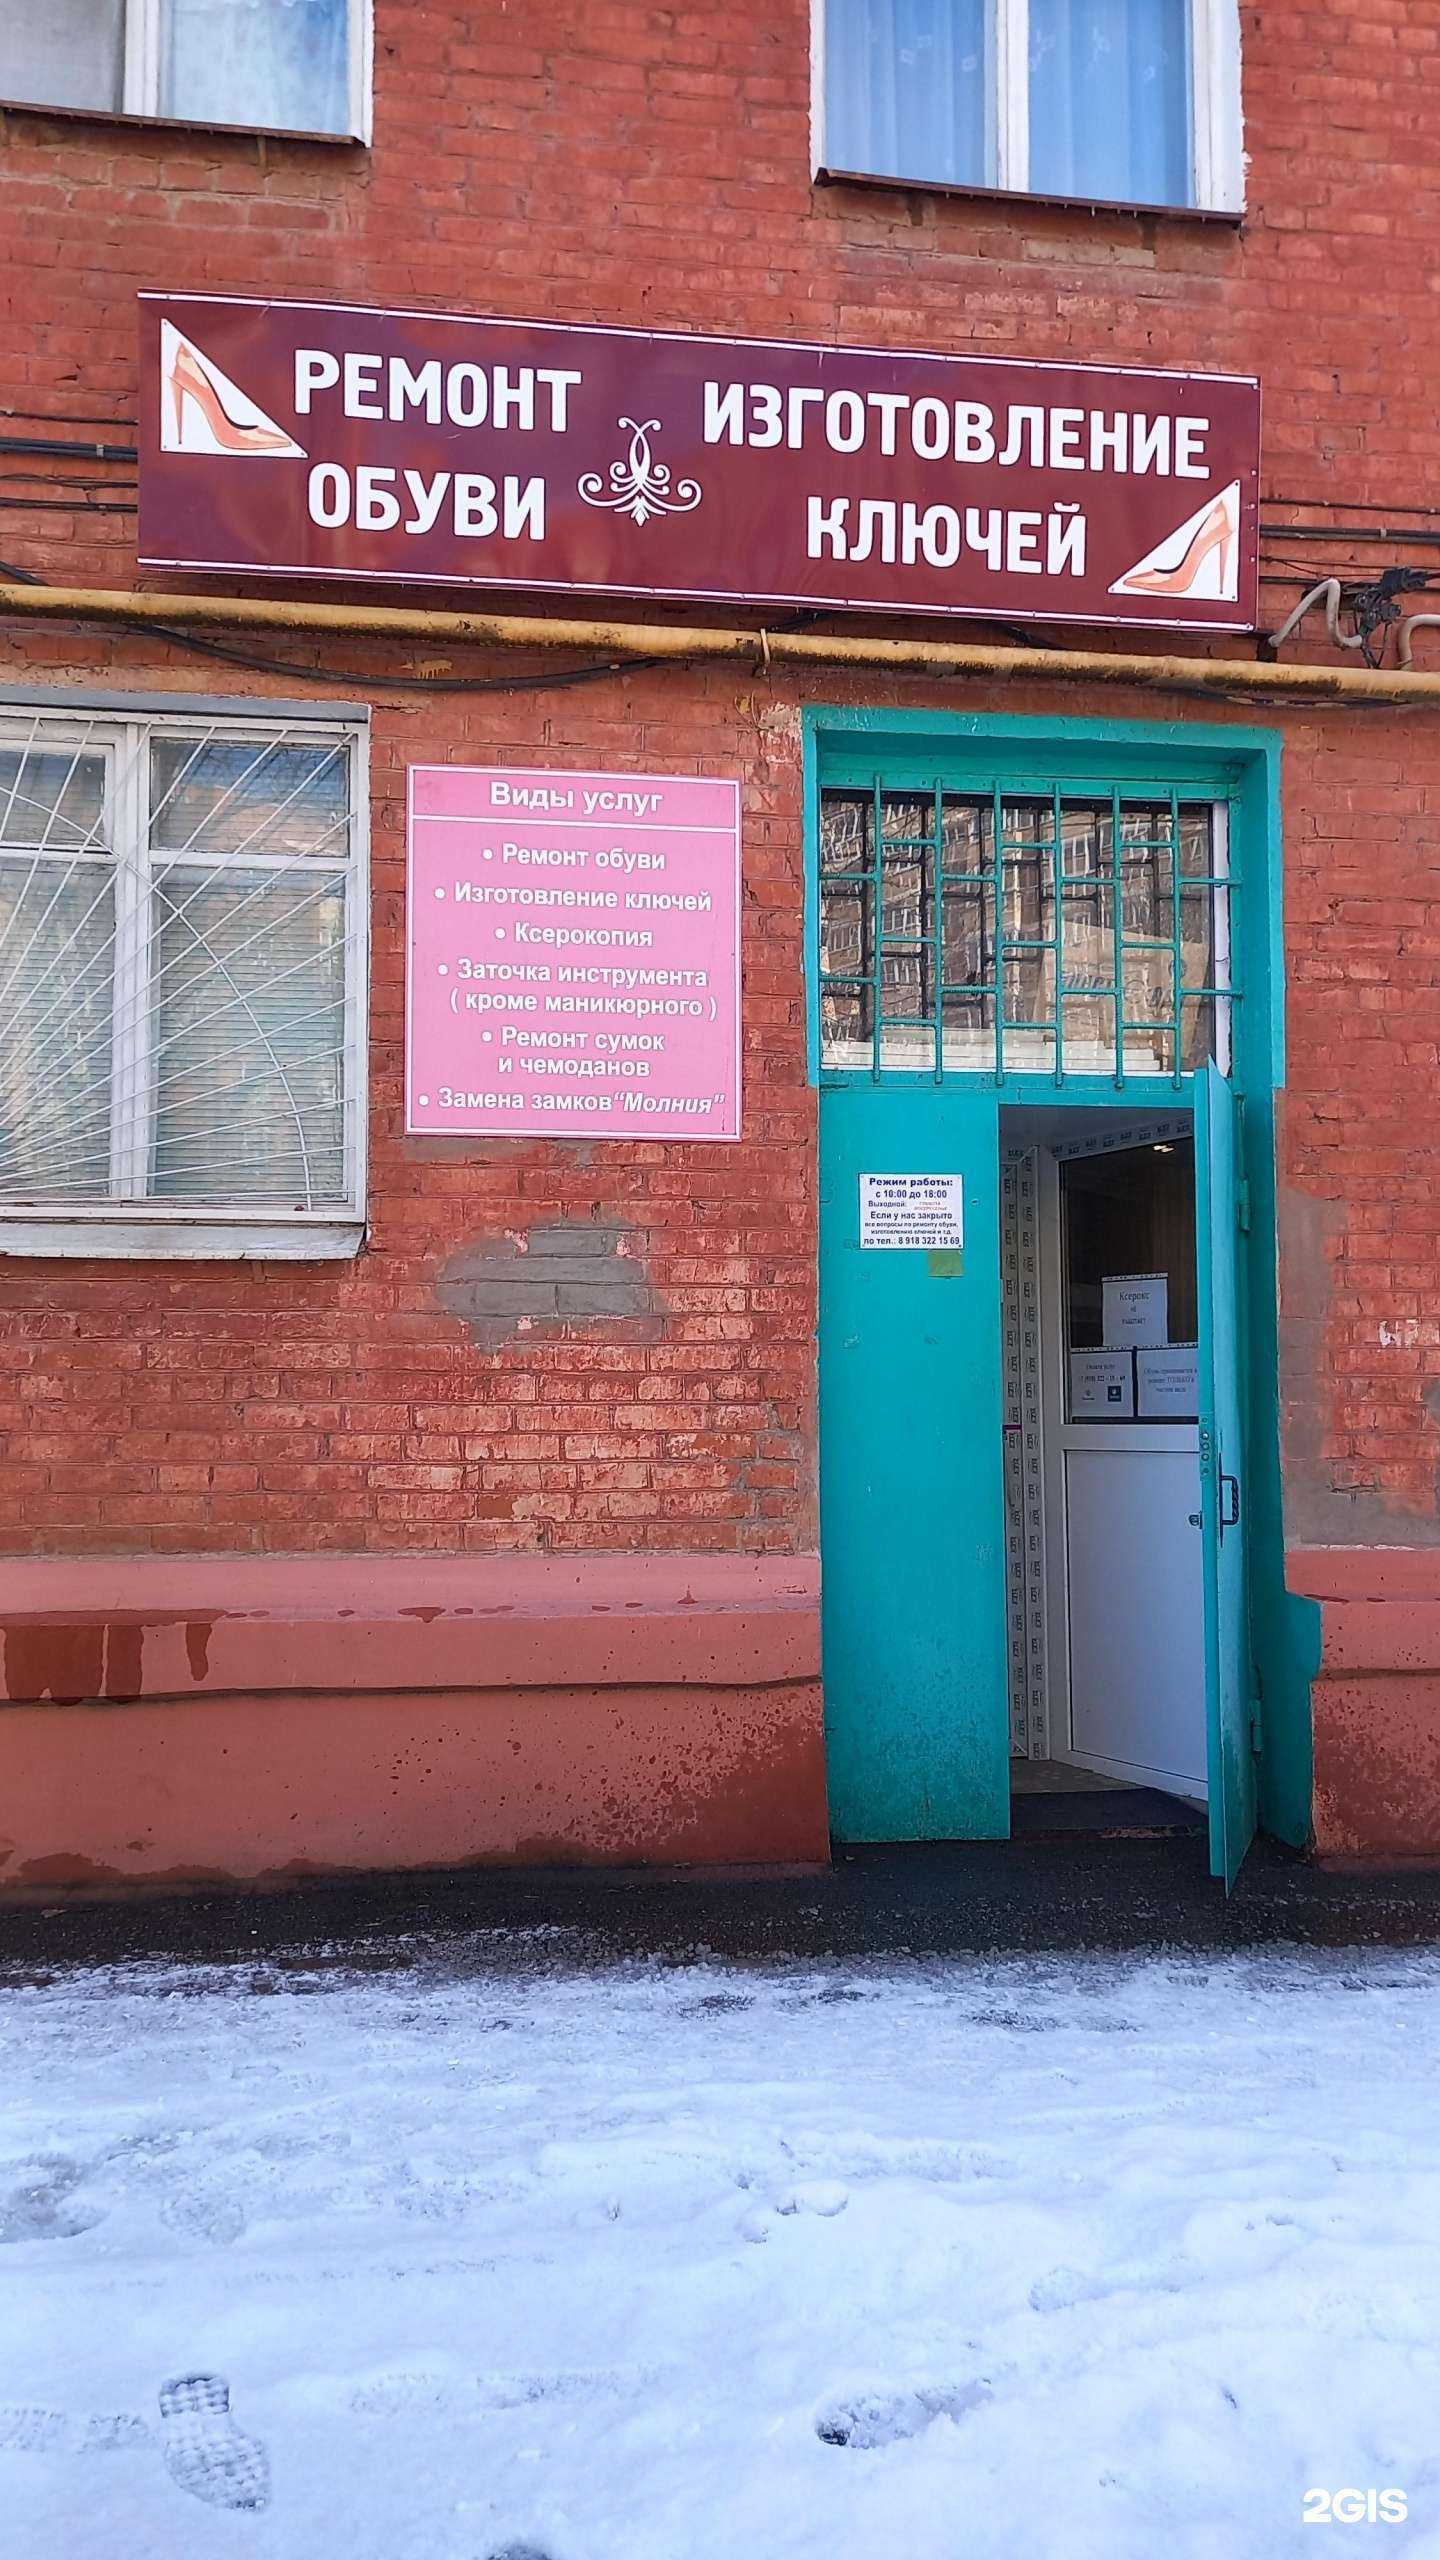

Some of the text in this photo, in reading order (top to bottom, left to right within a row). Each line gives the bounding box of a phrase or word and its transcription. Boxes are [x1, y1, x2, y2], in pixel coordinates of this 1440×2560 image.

[294, 348, 583, 433] РЕМОНТ
[703, 380, 1211, 480] ИЗГОТОВЛЕНИЕ
[307, 461, 546, 541] ОБУВИ
[806, 495, 1087, 577] КЛЮЧЕЙ
[490, 781, 664, 817] Виды услуг
[502, 843, 666, 874] Ремонт обуви
[455, 881, 713, 912] Изготовление ключей
[514, 921, 653, 951] Ксерокопия
[457, 957, 708, 990] Заточка инструмента
[501, 1025, 665, 1054] Ремонт сумок
[498, 1057, 650, 1079] и чемоданов
[438, 1086, 524, 1110] Замена
[869, 1177, 953, 1188] Режим работы:
[875, 1189, 948, 1200] с 10:00 до 18:00
[870, 1211, 892, 1220] Если
[893, 1213, 899, 1221] у
[918, 1212, 953, 1221] закрыто
[863, 1237, 875, 1245] по
[898, 1236, 904, 1245] 8
[905, 1236, 920, 1245] 918
[921, 1236, 937, 1245] 322
[939, 1236, 948, 1245] 15
[949, 1236, 960, 1245] 69
